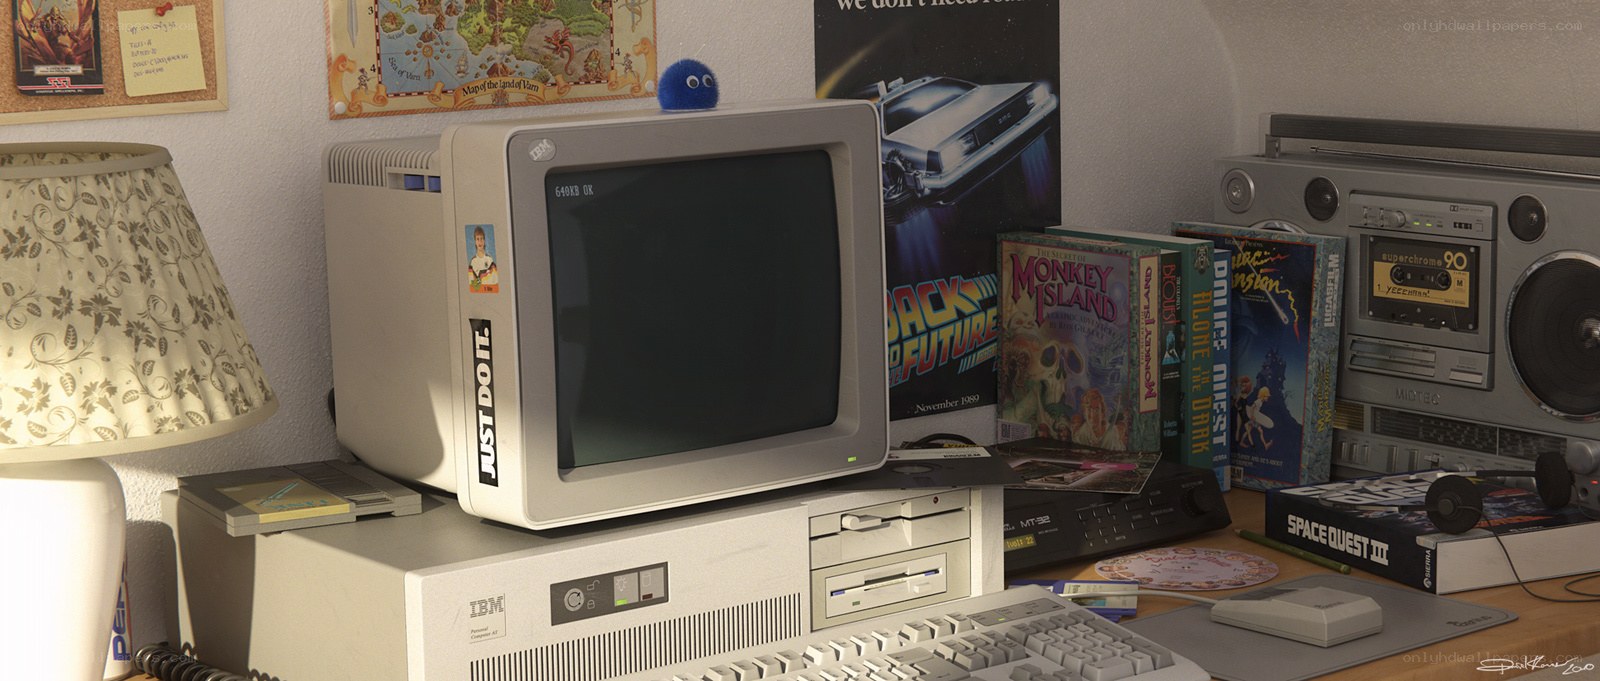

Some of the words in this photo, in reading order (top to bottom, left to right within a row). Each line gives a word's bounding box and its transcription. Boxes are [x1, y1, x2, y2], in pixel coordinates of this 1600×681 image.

[367, 6, 374, 16] 3
[369, 64, 376, 72] 4
[614, 47, 621, 56] 4
[462, 83, 481, 97] Map
[480, 82, 488, 92] of
[487, 80, 498, 90] the
[514, 79, 522, 91] of
[522, 80, 540, 93] Varn
[529, 138, 551, 161] IBM
[555, 185, 580, 198] 640KB
[583, 184, 594, 196] OK
[1010, 254, 1115, 304] MONKEY
[1381, 253, 1443, 269] superchrome
[1443, 250, 1468, 271] 90
[1035, 283, 1119, 328] ISLAND
[1144, 266, 1156, 325] ISLAND
[1213, 259, 1228, 352] POLICE
[474, 327, 491, 360] IT.
[901, 306, 998, 382] FUTURE
[1192, 290, 1213, 360] ALONE
[476, 362, 493, 408] DO
[1144, 328, 1157, 401] MONKEY
[914, 399, 960, 414] November
[1191, 396, 1213, 454] DARK
[1213, 363, 1228, 447] QUEST
[479, 409, 497, 480] JUST
[1020, 514, 1052, 532] MT-32
[1287, 513, 1328, 546] SPACE
[1328, 525, 1370, 560] QUEST
[1370, 538, 1389, 567] III
[470, 596, 503, 618] IBM
